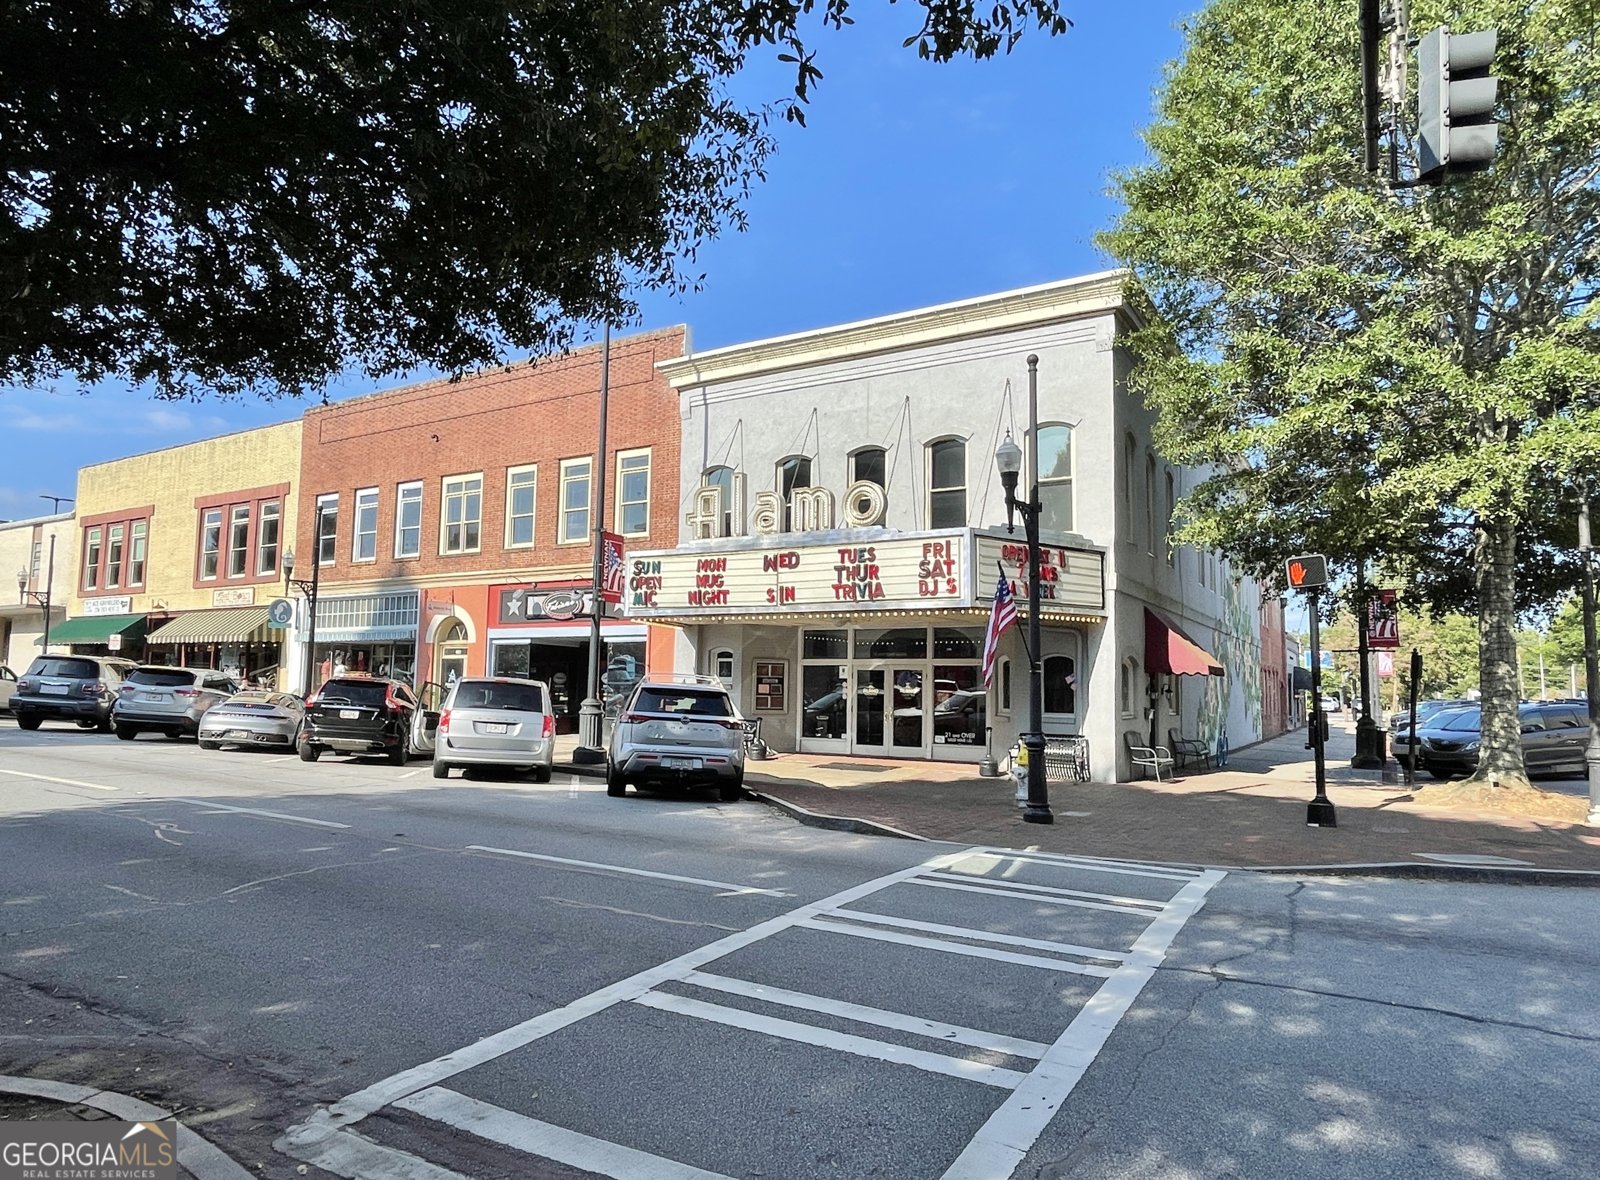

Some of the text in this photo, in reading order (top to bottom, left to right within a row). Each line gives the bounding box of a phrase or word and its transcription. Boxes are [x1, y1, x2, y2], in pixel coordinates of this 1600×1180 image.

[686, 472, 887, 540] Alamo
[837, 547, 877, 564] TUES
[922, 540, 951, 560] FRI
[633, 560, 662, 576] SUN
[696, 558, 727, 573] MON
[763, 551, 800, 572] WED
[918, 559, 955, 580] SAT
[696, 574, 724, 589] MUG
[834, 564, 879, 583] THUR
[629, 576, 662, 592] OPEN
[832, 581, 886, 602] TRIVIA
[632, 590, 658, 607] MIC
[688, 590, 730, 606] NIGHT
